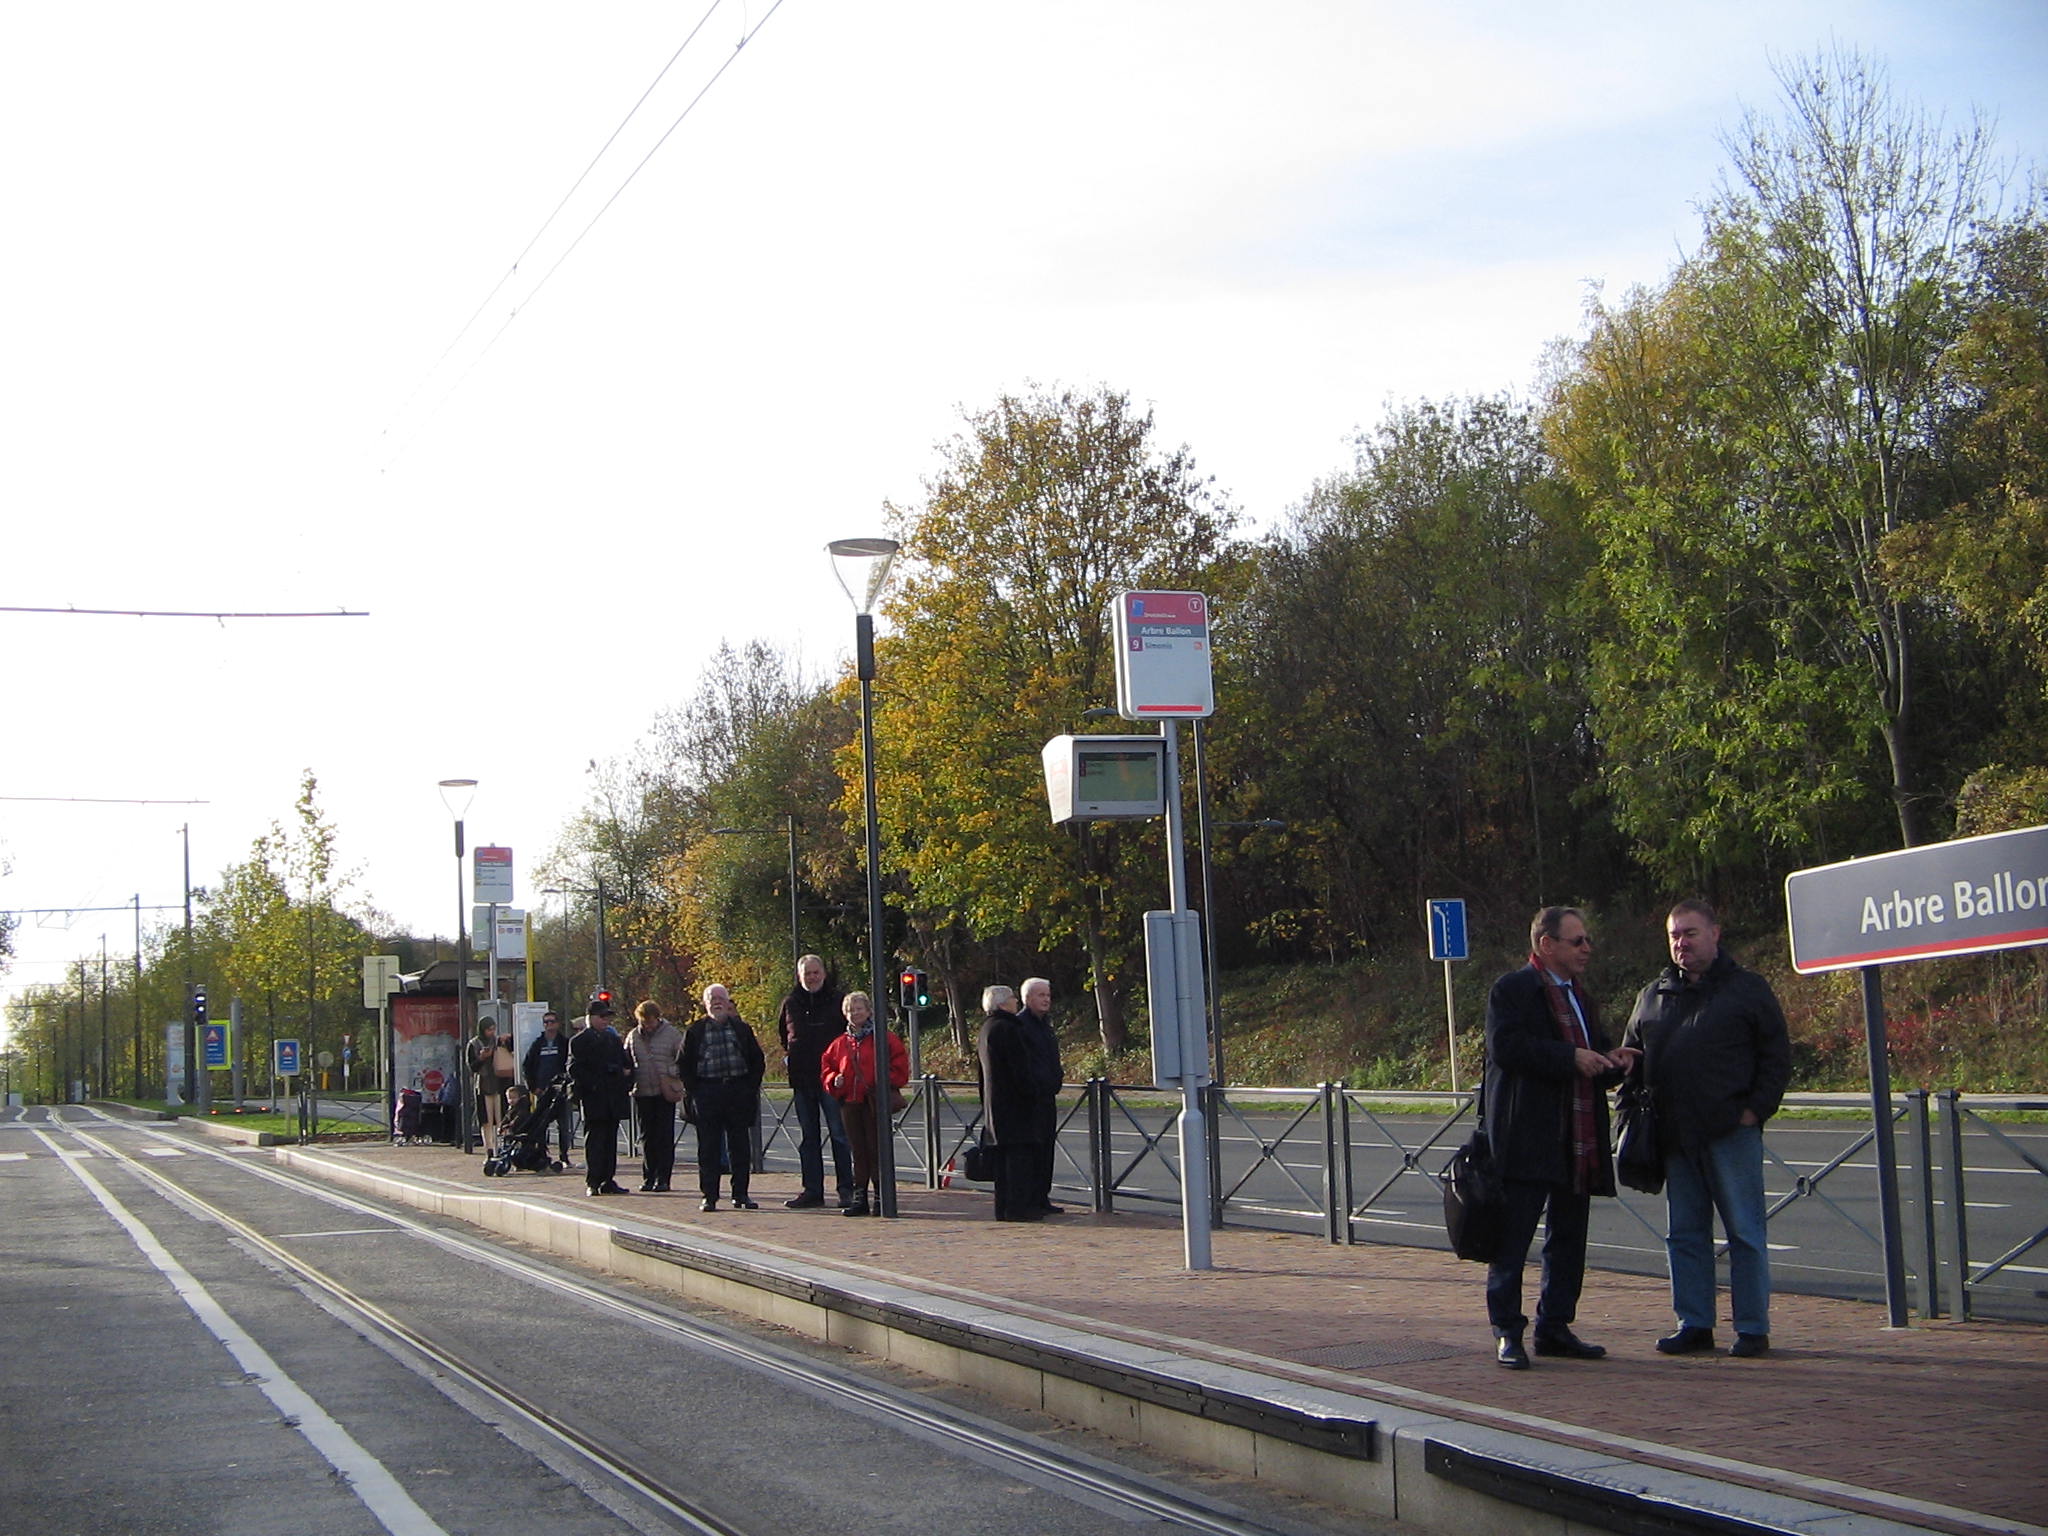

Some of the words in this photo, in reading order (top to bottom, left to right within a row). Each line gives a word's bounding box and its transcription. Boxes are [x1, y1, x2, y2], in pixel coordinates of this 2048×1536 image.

[1141, 627, 1164, 635] Arbre
[1166, 627, 1192, 635] Ballon
[1132, 639, 1140, 650] 9
[1860, 889, 1944, 934] Arbre
